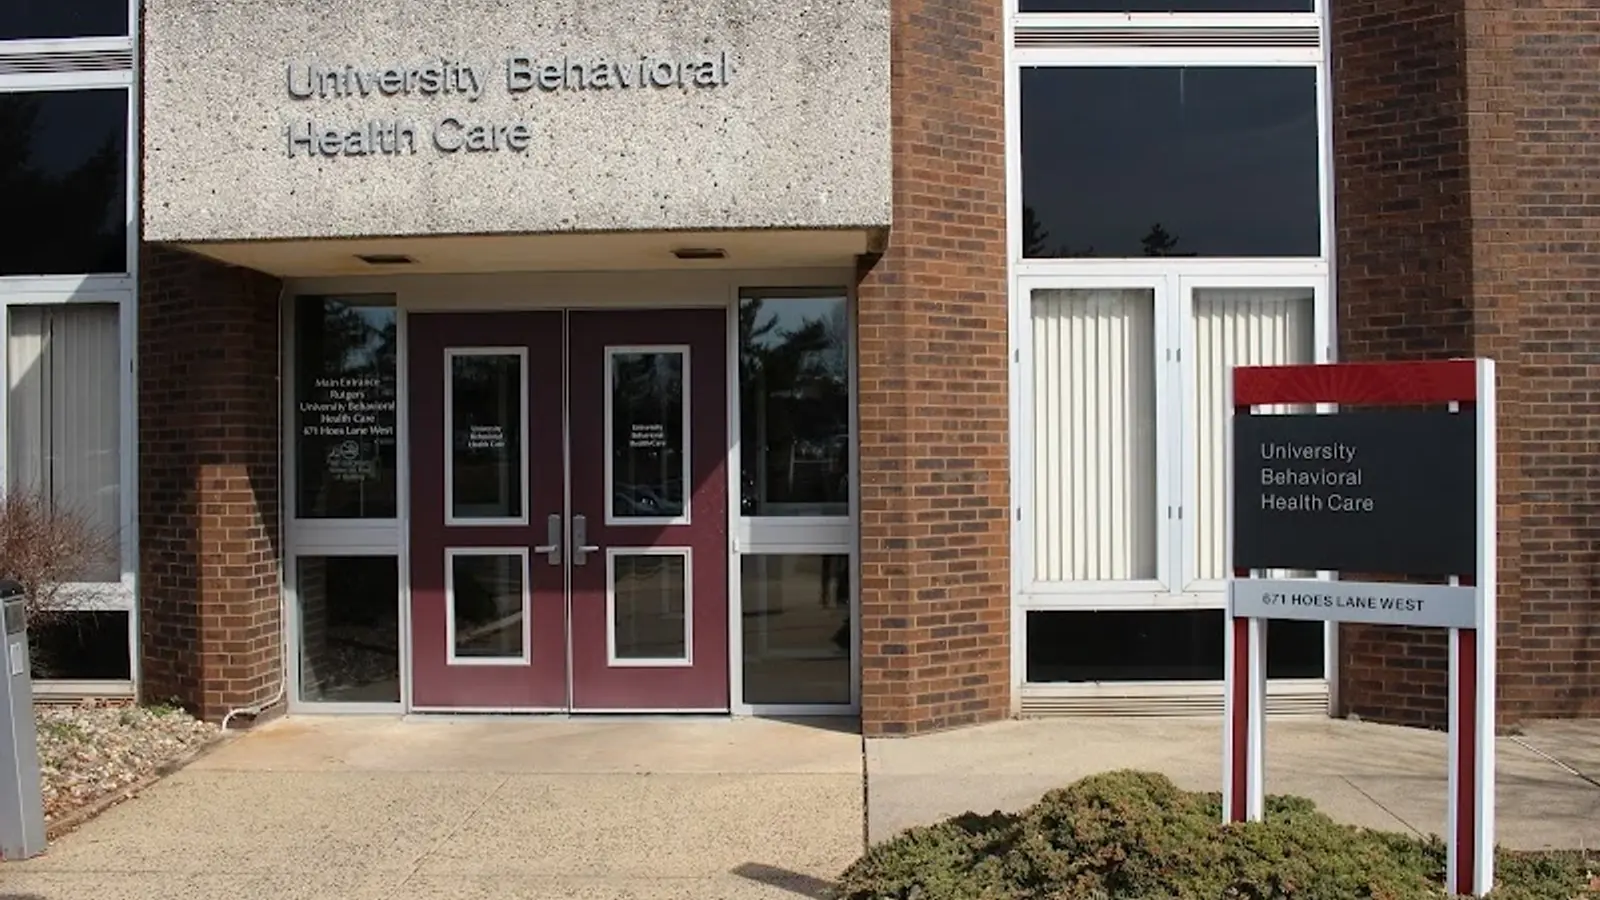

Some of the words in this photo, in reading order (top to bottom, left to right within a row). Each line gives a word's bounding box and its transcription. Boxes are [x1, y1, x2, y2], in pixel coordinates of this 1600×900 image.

[286, 59, 489, 102] University
[505, 52, 733, 93] Behavioral
[285, 117, 416, 158] Health
[432, 117, 532, 154] Care
[1260, 442, 1357, 463] University
[1260, 468, 1362, 486] Behavioral
[1260, 494, 1323, 511] Health
[1327, 494, 1375, 512] Care
[1262, 592, 1286, 605] 671
[1291, 593, 1333, 607] HOES
[1336, 595, 1377, 609] LANE
[1380, 597, 1425, 611] WEST
